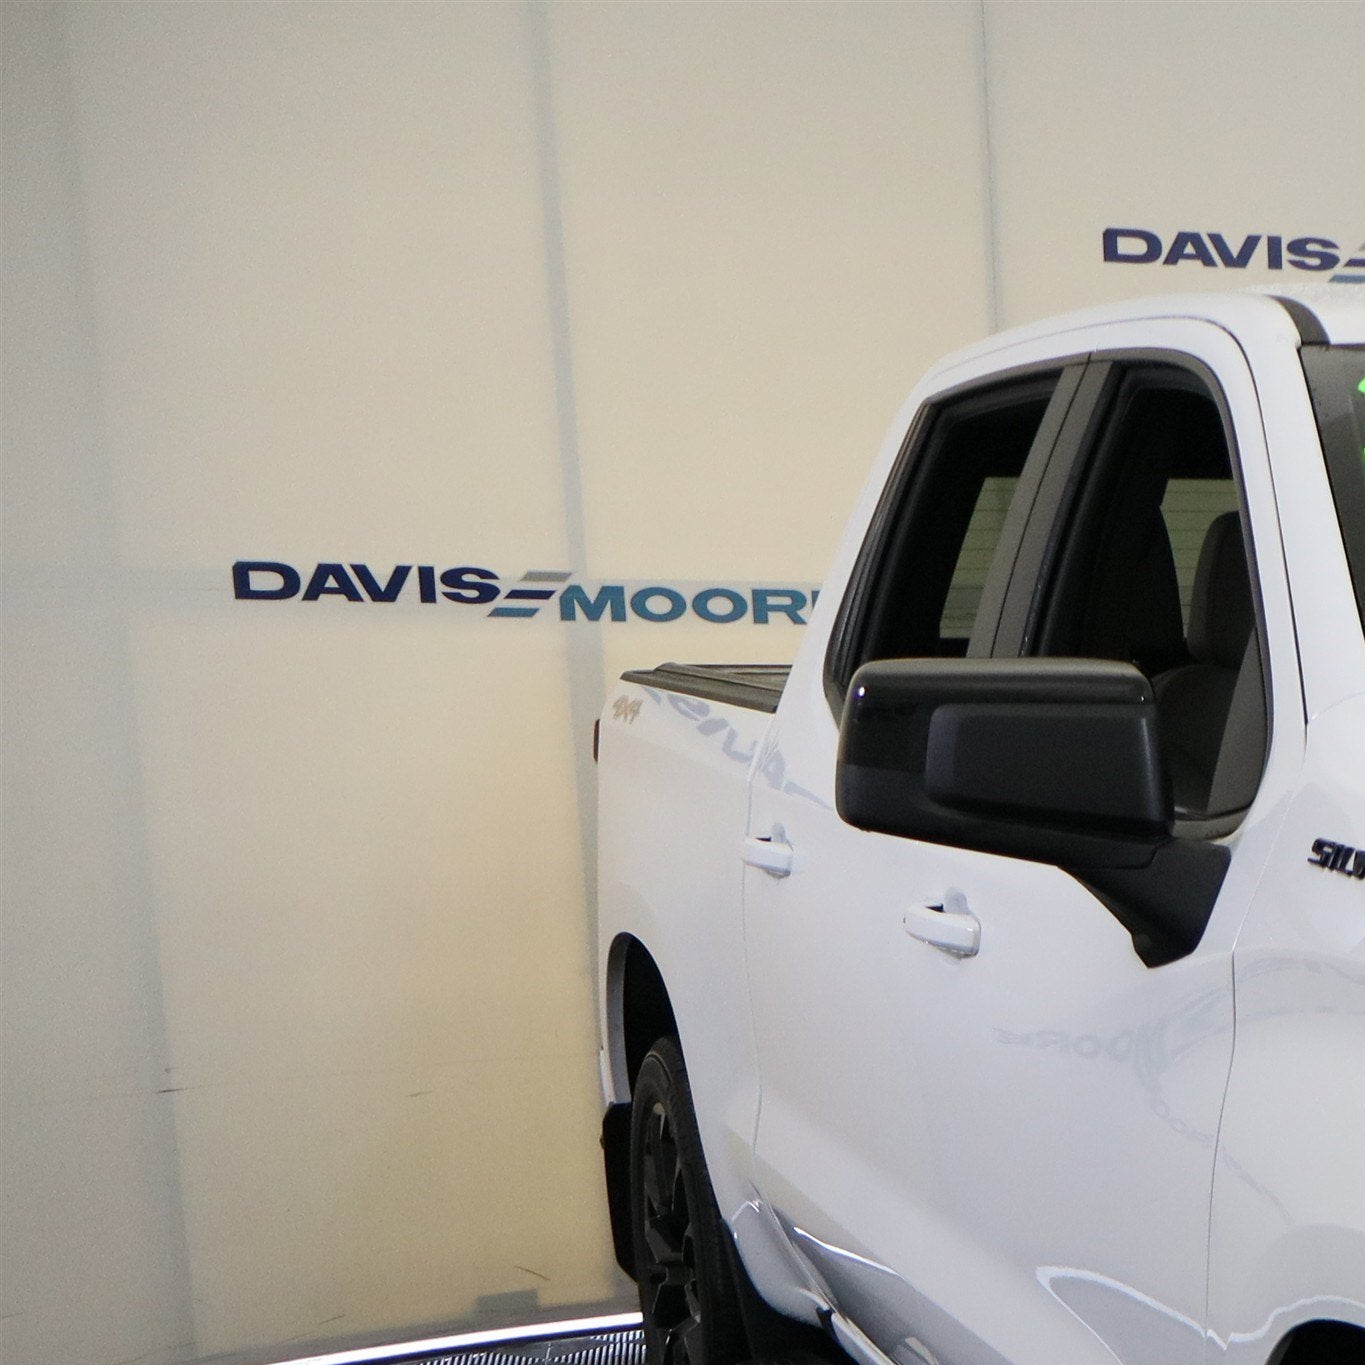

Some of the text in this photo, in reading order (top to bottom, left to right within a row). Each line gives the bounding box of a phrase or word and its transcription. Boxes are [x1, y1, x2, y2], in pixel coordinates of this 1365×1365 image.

[1103, 228, 1341, 271] DAVIS
[232, 561, 821, 625] DAVIS MOOR
